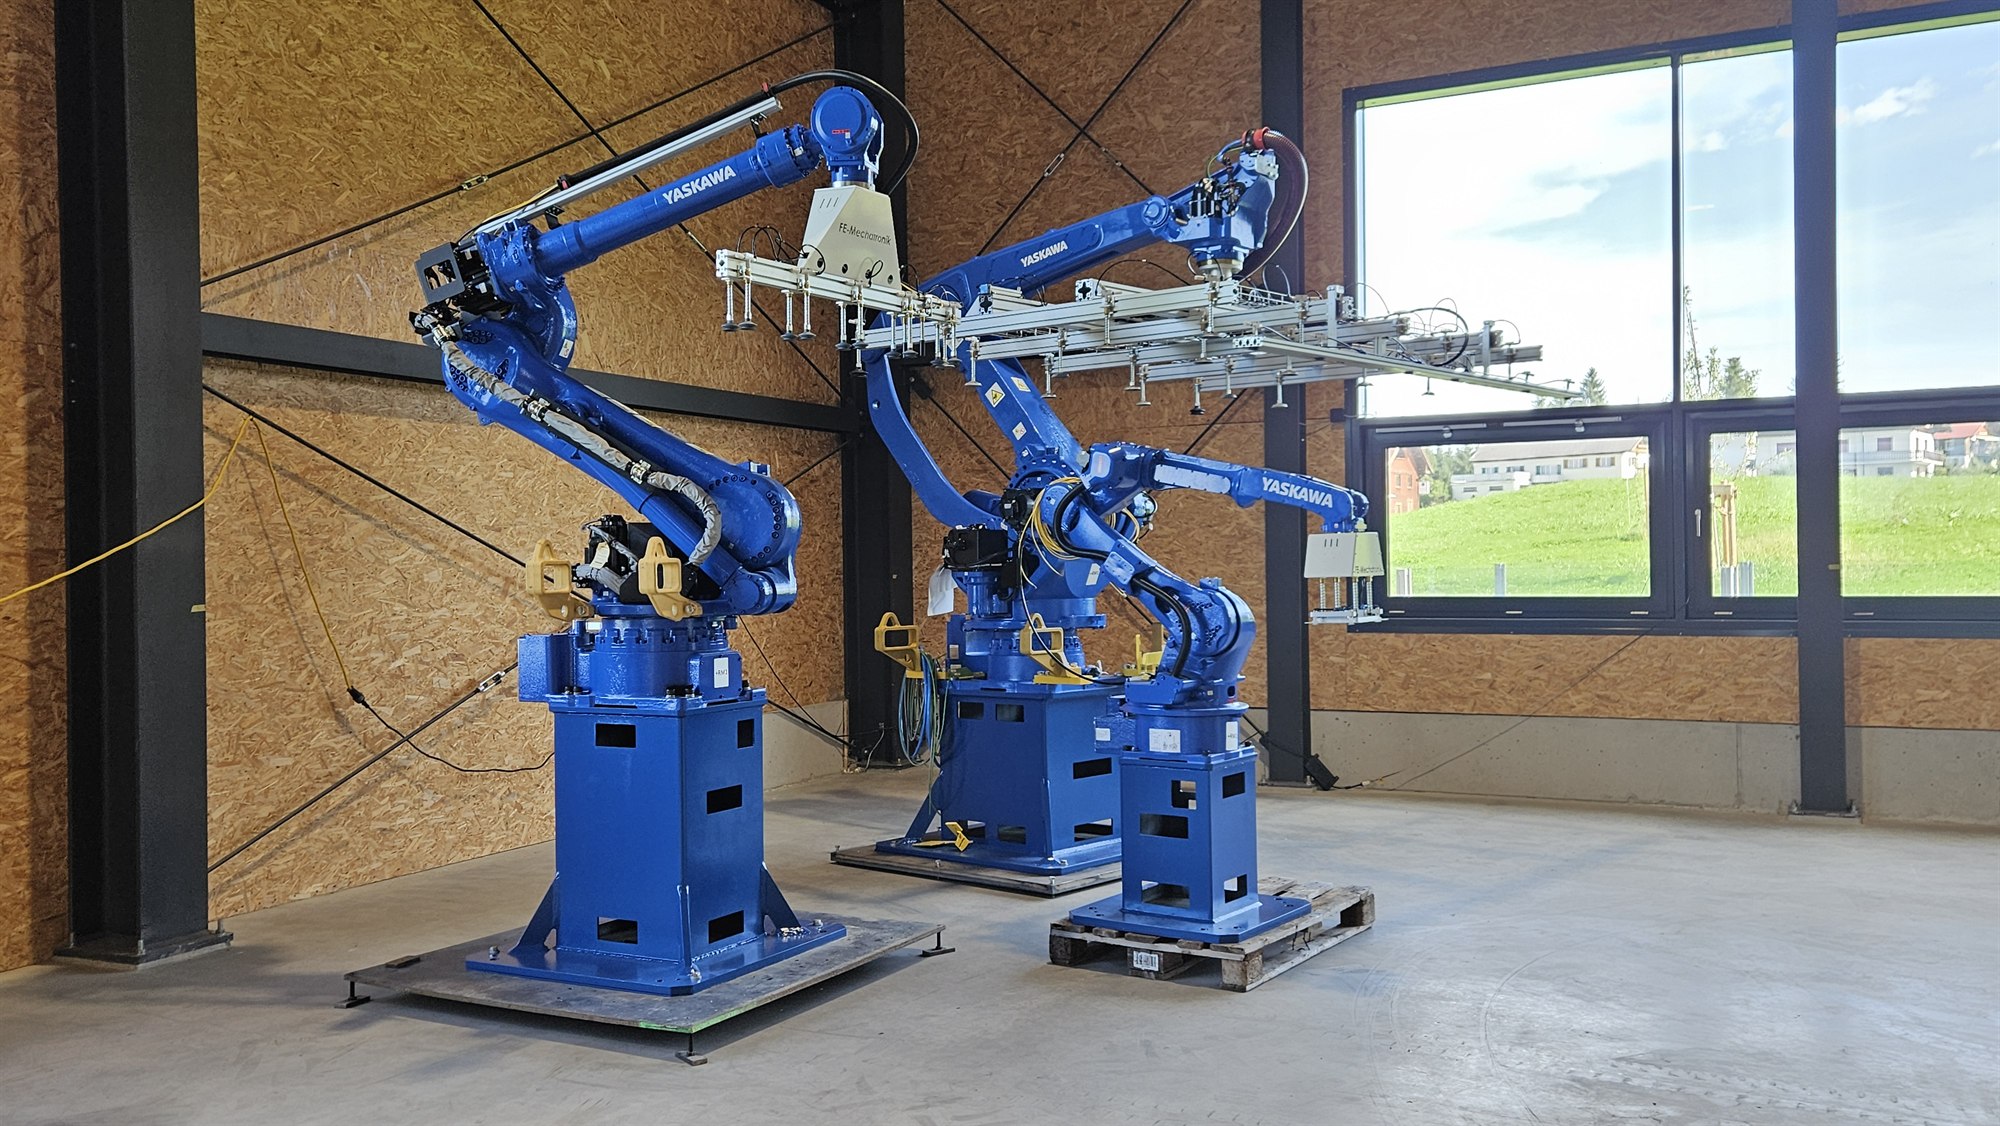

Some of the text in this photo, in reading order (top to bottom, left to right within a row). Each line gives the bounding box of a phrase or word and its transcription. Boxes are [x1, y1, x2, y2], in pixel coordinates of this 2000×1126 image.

[662, 165, 737, 205] YASKAWA
[1020, 240, 1068, 268] YASKAWA
[1262, 477, 1333, 508] YASKAWA
